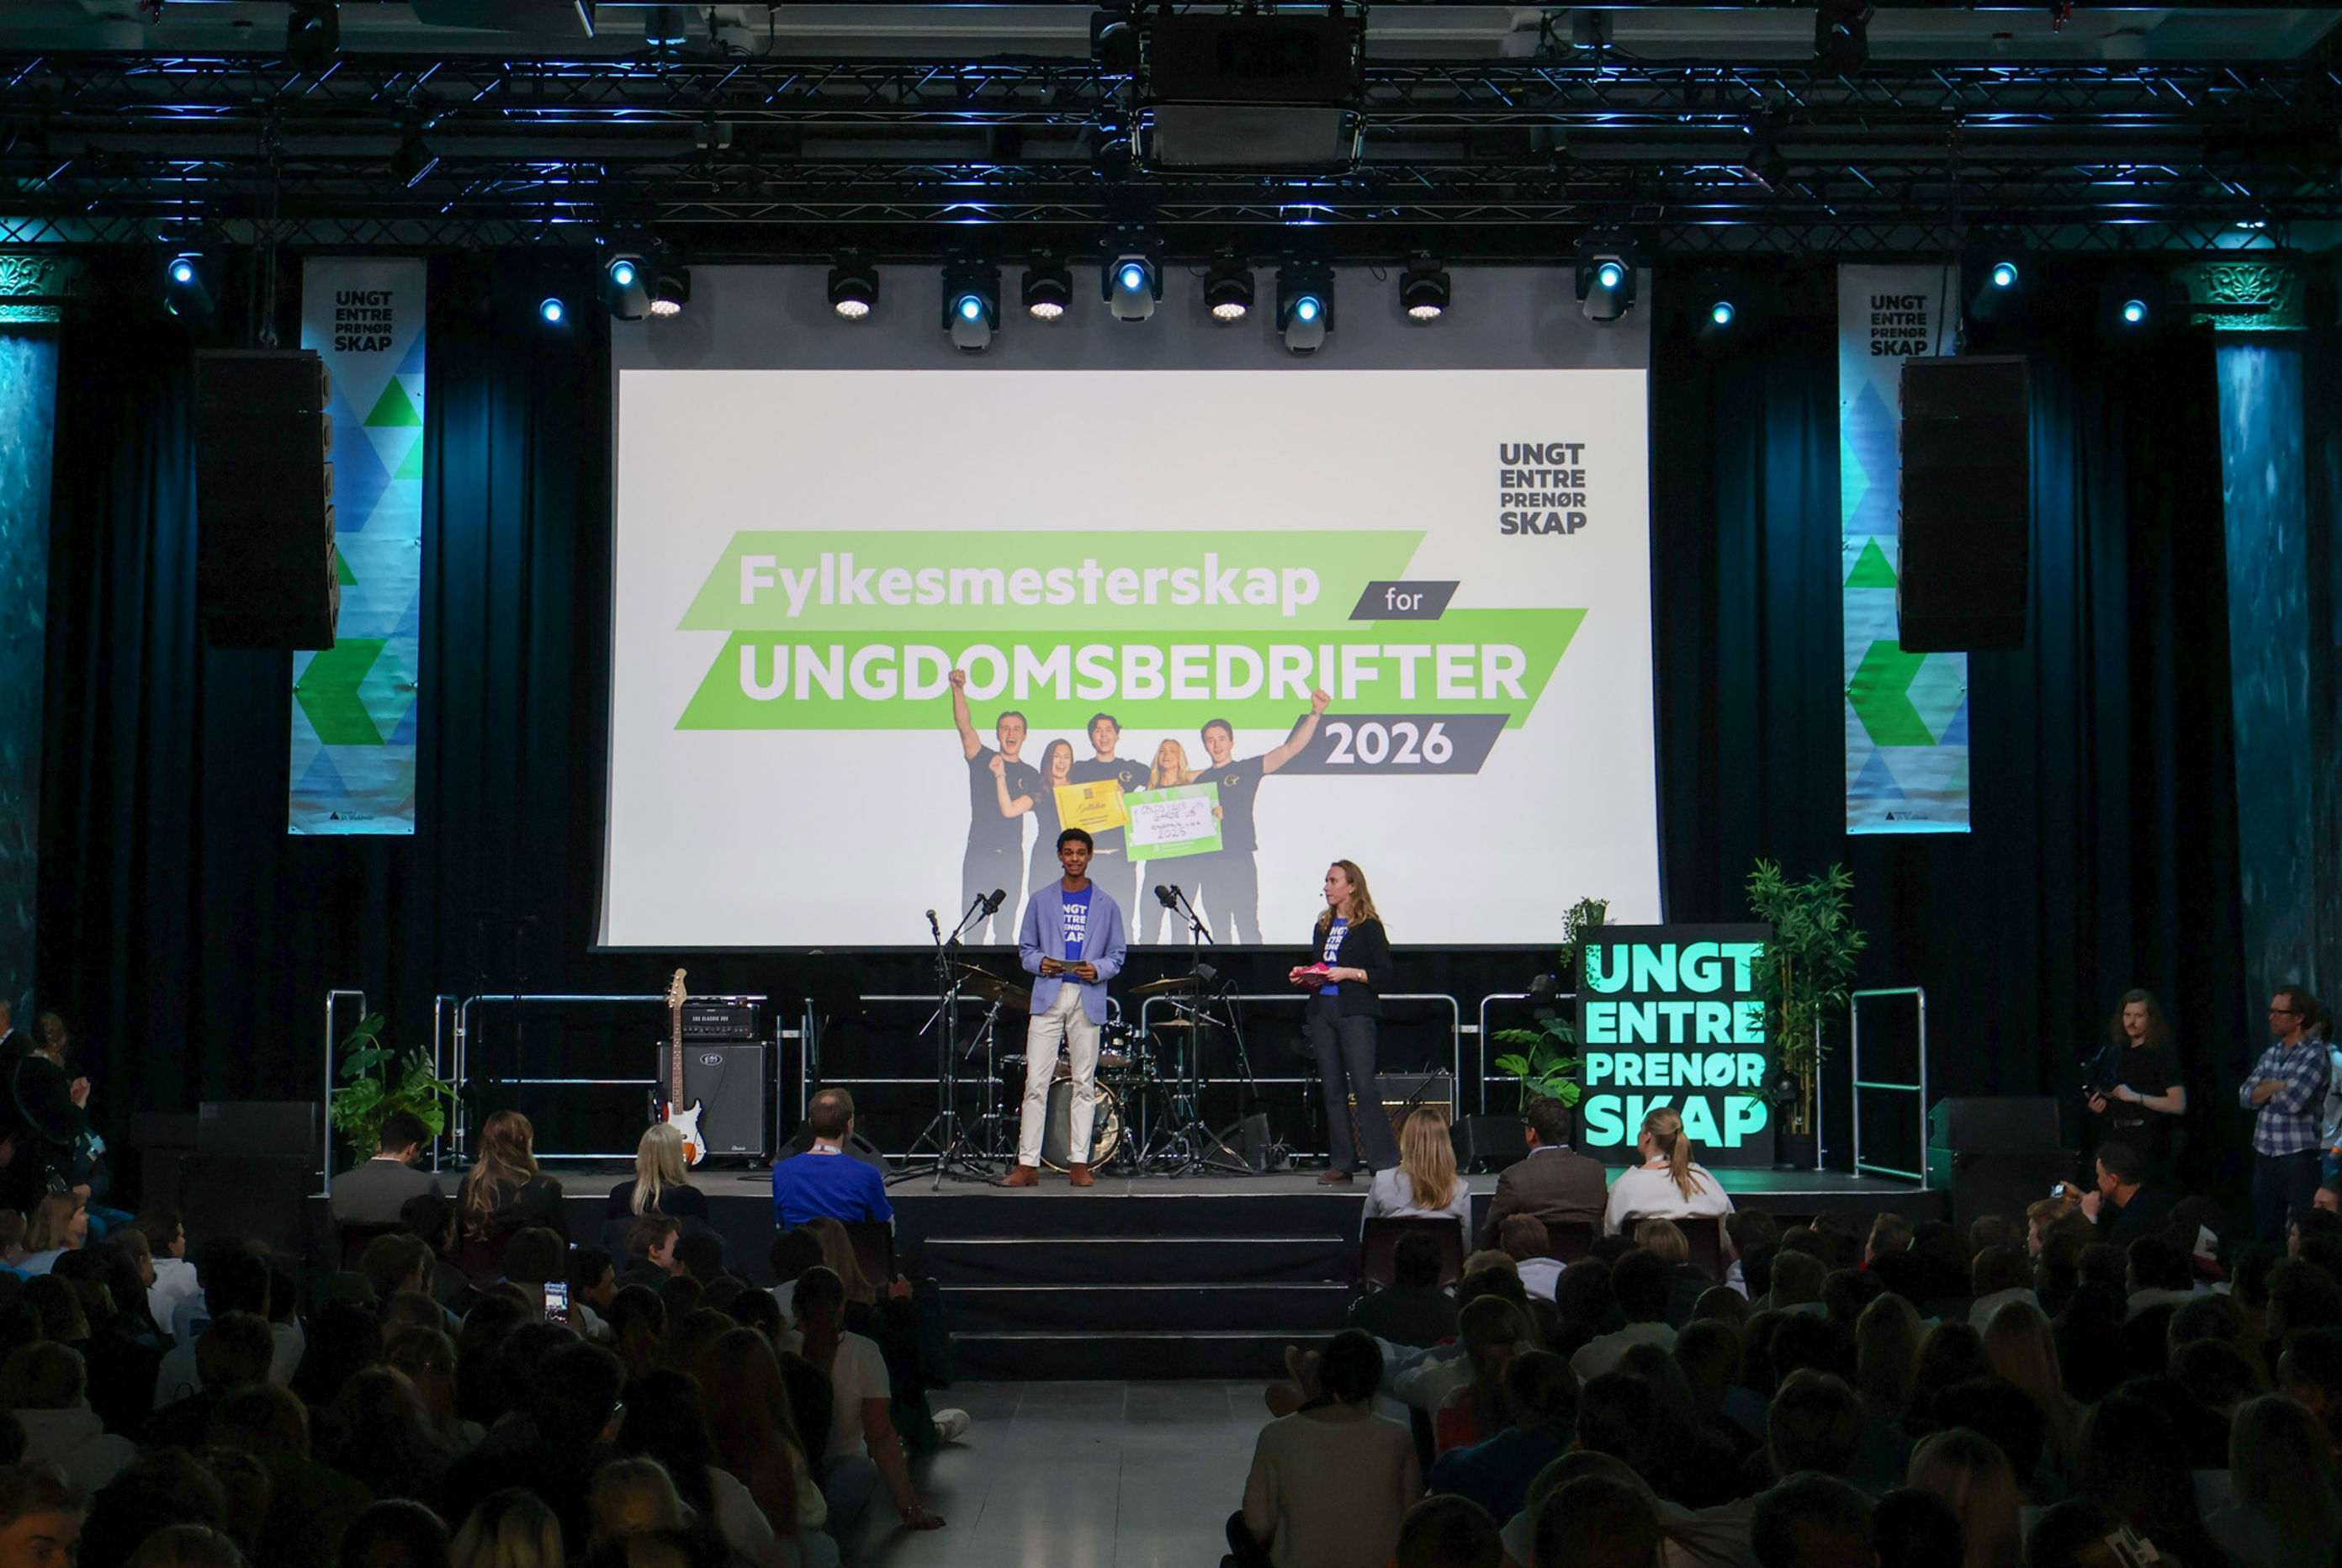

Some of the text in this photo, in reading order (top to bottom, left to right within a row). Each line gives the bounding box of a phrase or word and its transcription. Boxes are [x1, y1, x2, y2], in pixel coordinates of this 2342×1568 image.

[336, 291, 393, 306] UNGT
[1871, 295, 1927, 310] UNGT
[336, 309, 392, 321] ENTRE
[1871, 313, 1926, 325] ENTRE
[335, 324, 392, 334] PRENØR
[1871, 328, 1926, 338] PRENØR
[335, 336, 393, 352] SKAP
[1871, 341, 1927, 356] SKAP
[1500, 442, 1585, 465] UNGT
[1501, 469, 1586, 488] ENTRE
[1501, 492, 1587, 508] PRENØR
[1500, 511, 1587, 535] SKAP
[739, 552, 1423, 617] Fylkesmesterskap for
[739, 644, 1529, 701] UNGDOMSBEDRIFTER
[1324, 722, 1454, 765] 2026
[1062, 903, 1088, 914] NGT
[1063, 914, 1087, 924] TRE
[1585, 941, 1765, 993] UNGT
[1586, 1001, 1765, 1044] ENTRE
[1586, 1052, 1767, 1087] PRENØR
[1584, 1094, 1767, 1147] SKAP
